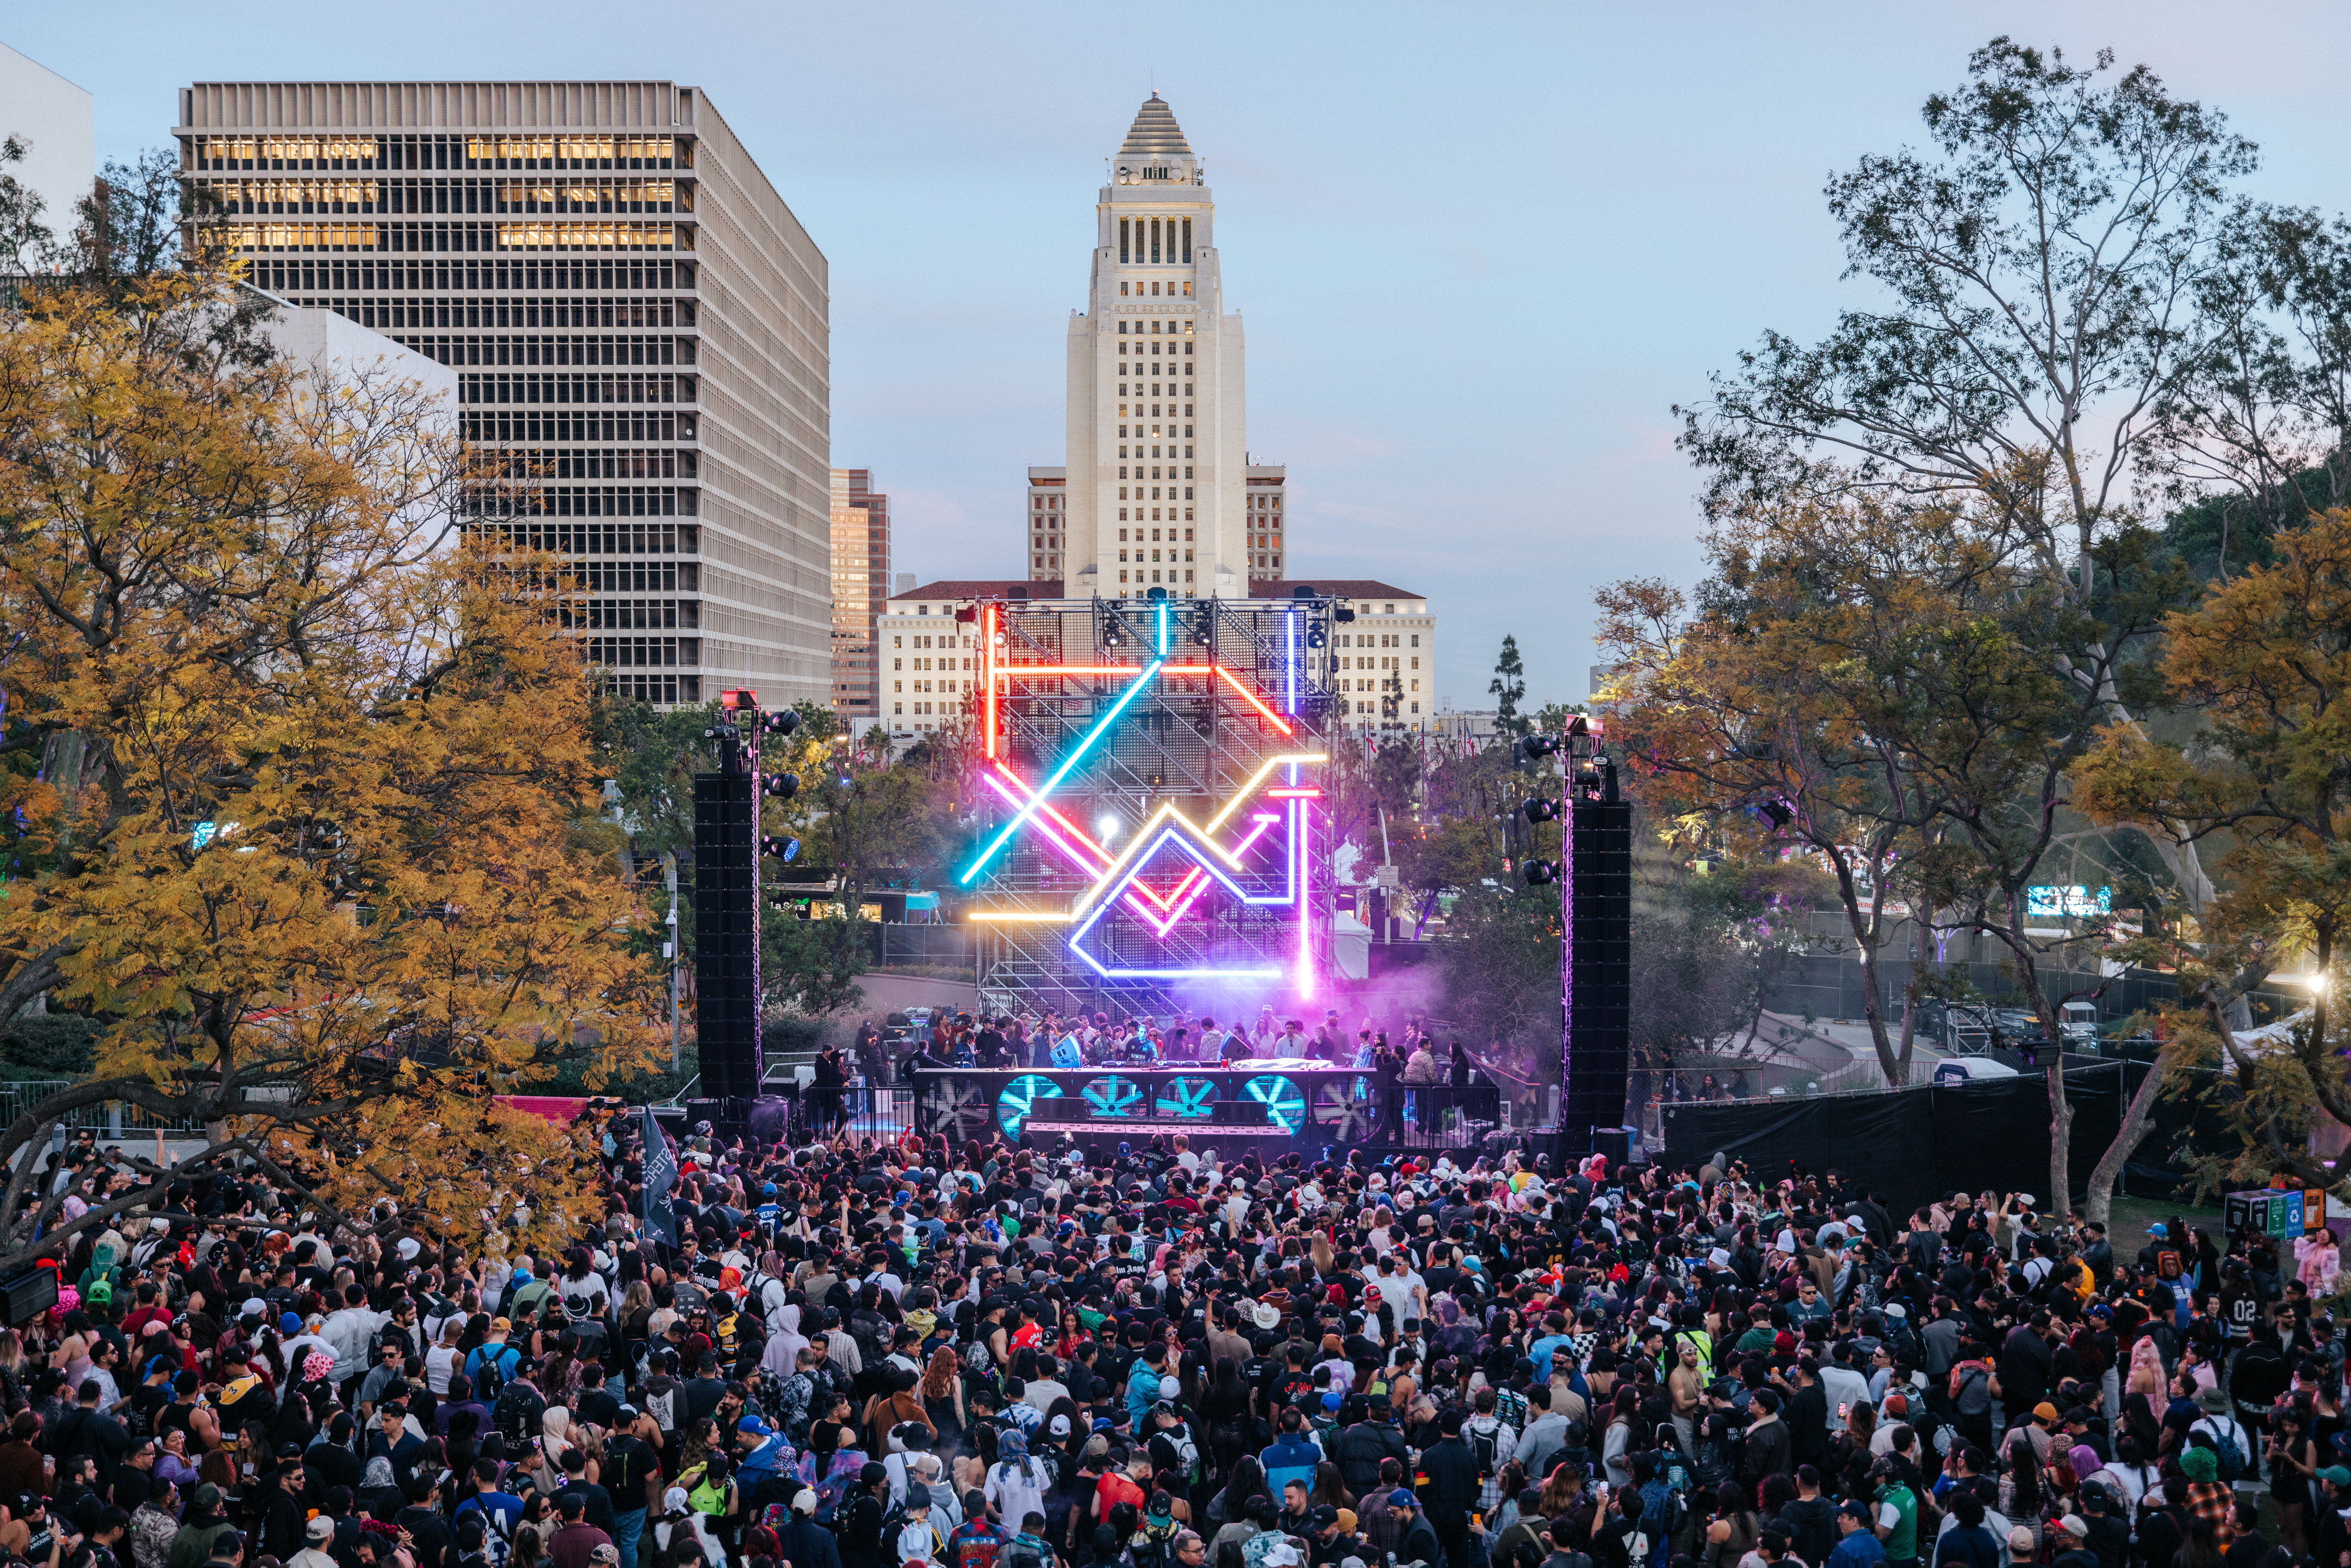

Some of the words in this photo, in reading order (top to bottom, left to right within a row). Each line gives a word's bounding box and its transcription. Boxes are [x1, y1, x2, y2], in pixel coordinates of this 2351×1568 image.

[783, 902, 806, 911] Sra
[2234, 1299, 2256, 1321] 02
[228, 1386, 238, 1395] M
[30, 1535, 51, 1551] AROUND
